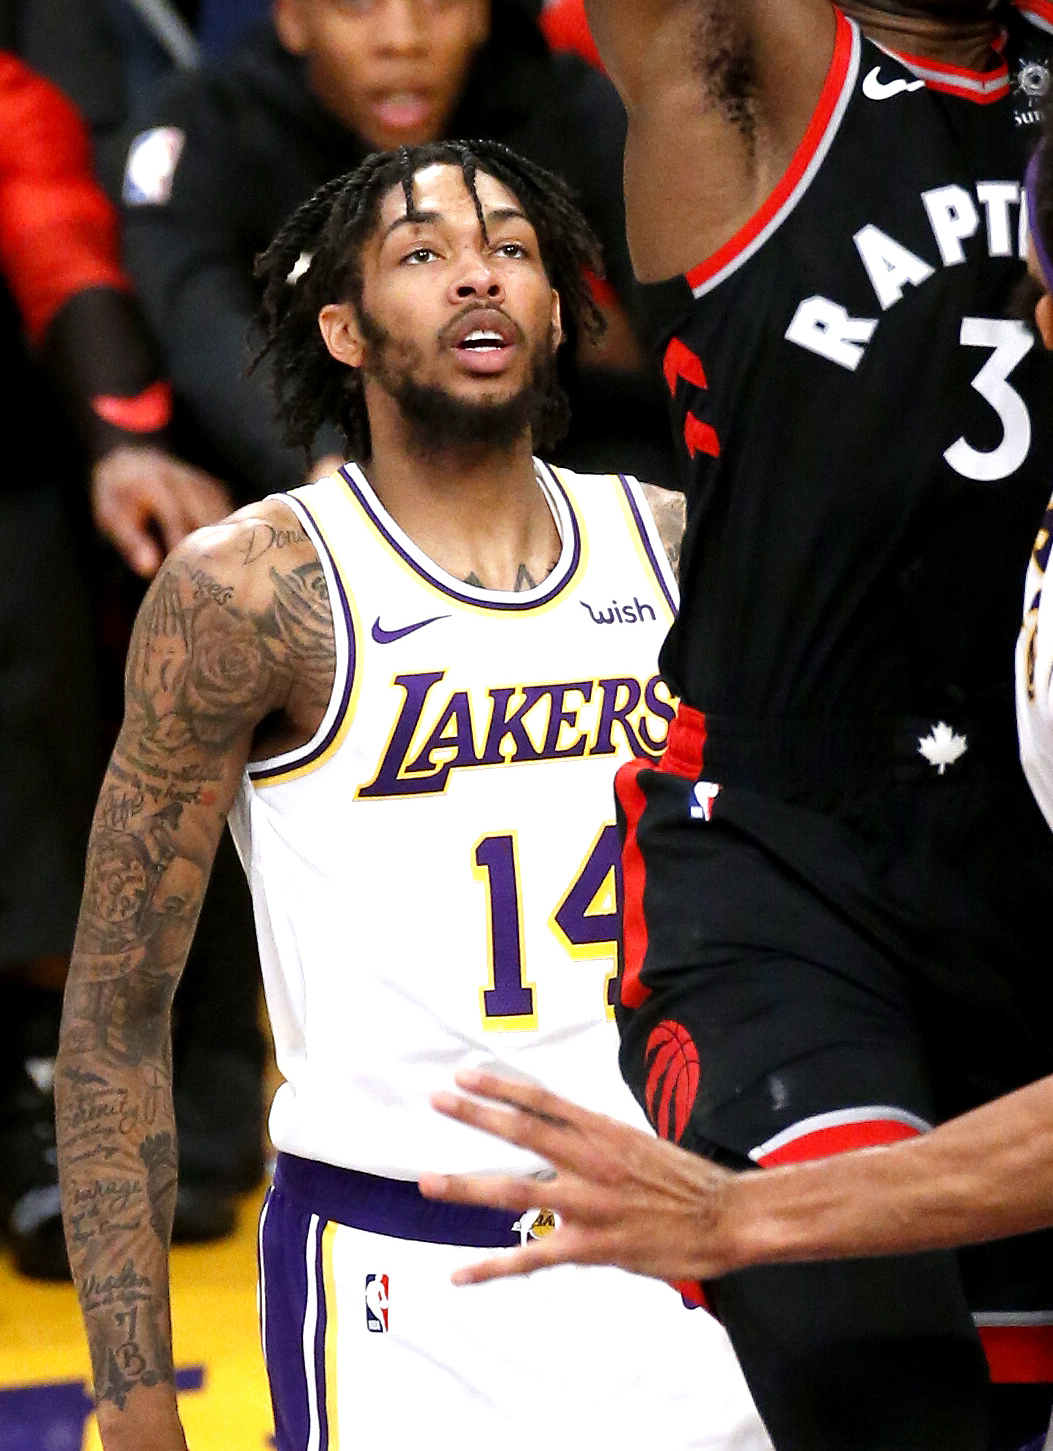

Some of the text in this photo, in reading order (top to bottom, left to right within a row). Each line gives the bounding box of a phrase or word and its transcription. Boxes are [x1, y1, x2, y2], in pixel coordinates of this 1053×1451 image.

[784, 180, 1029, 372] RAPT
[943, 316, 1034, 481] 3
[579, 596, 657, 624] wish
[353, 667, 678, 801] LAKERS
